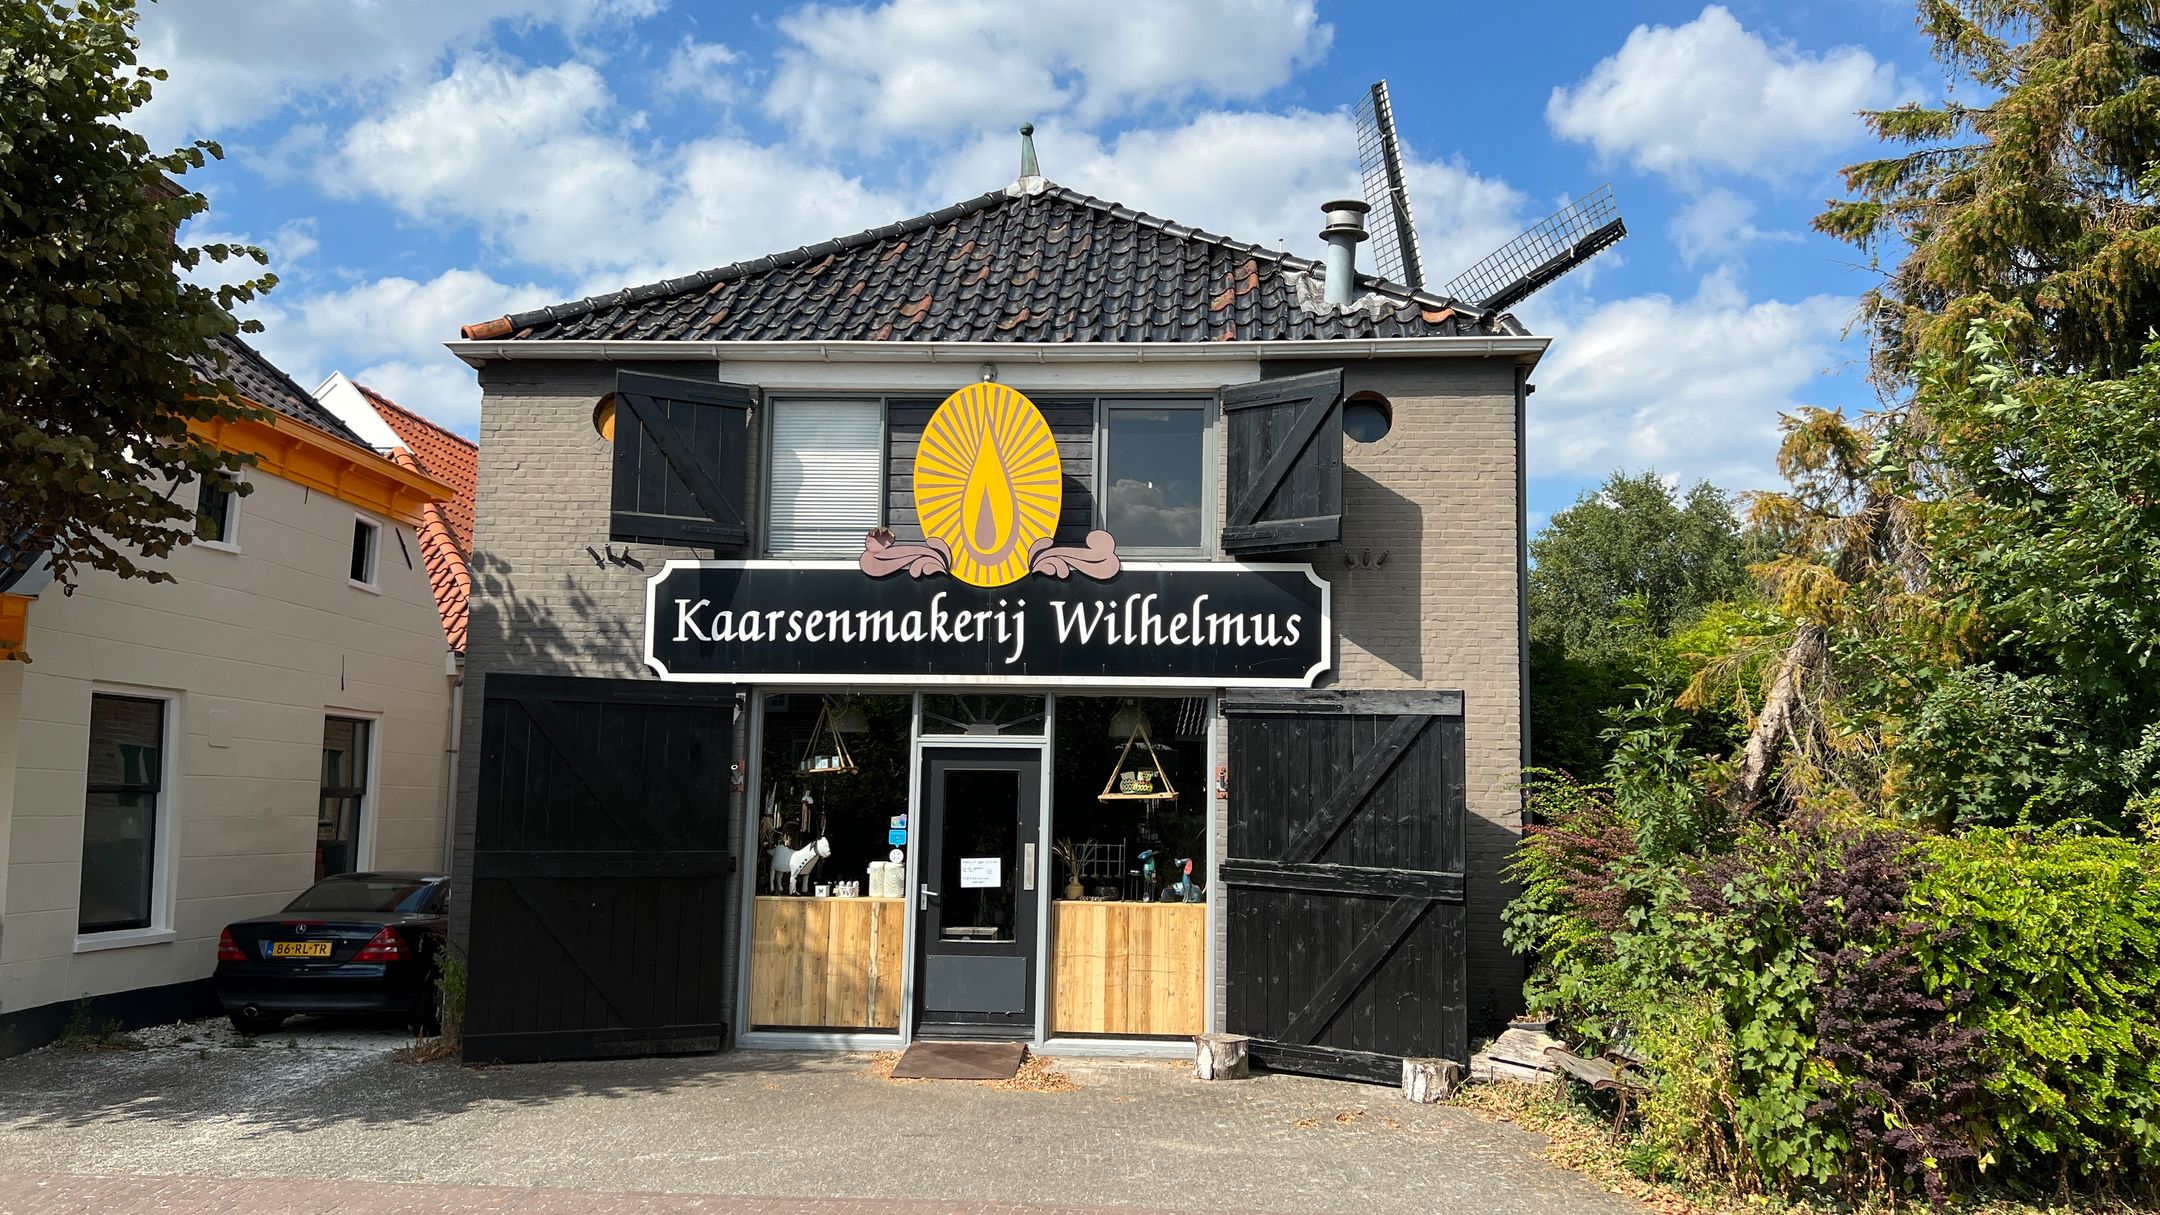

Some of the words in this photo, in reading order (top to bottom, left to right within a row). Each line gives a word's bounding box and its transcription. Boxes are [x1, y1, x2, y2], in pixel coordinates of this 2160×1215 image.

[672, 591, 1026, 664] Kaarsenmakerij
[1049, 593, 1302, 647] Wilhelmus
[276, 943, 327, 954] 86-RL-TR
